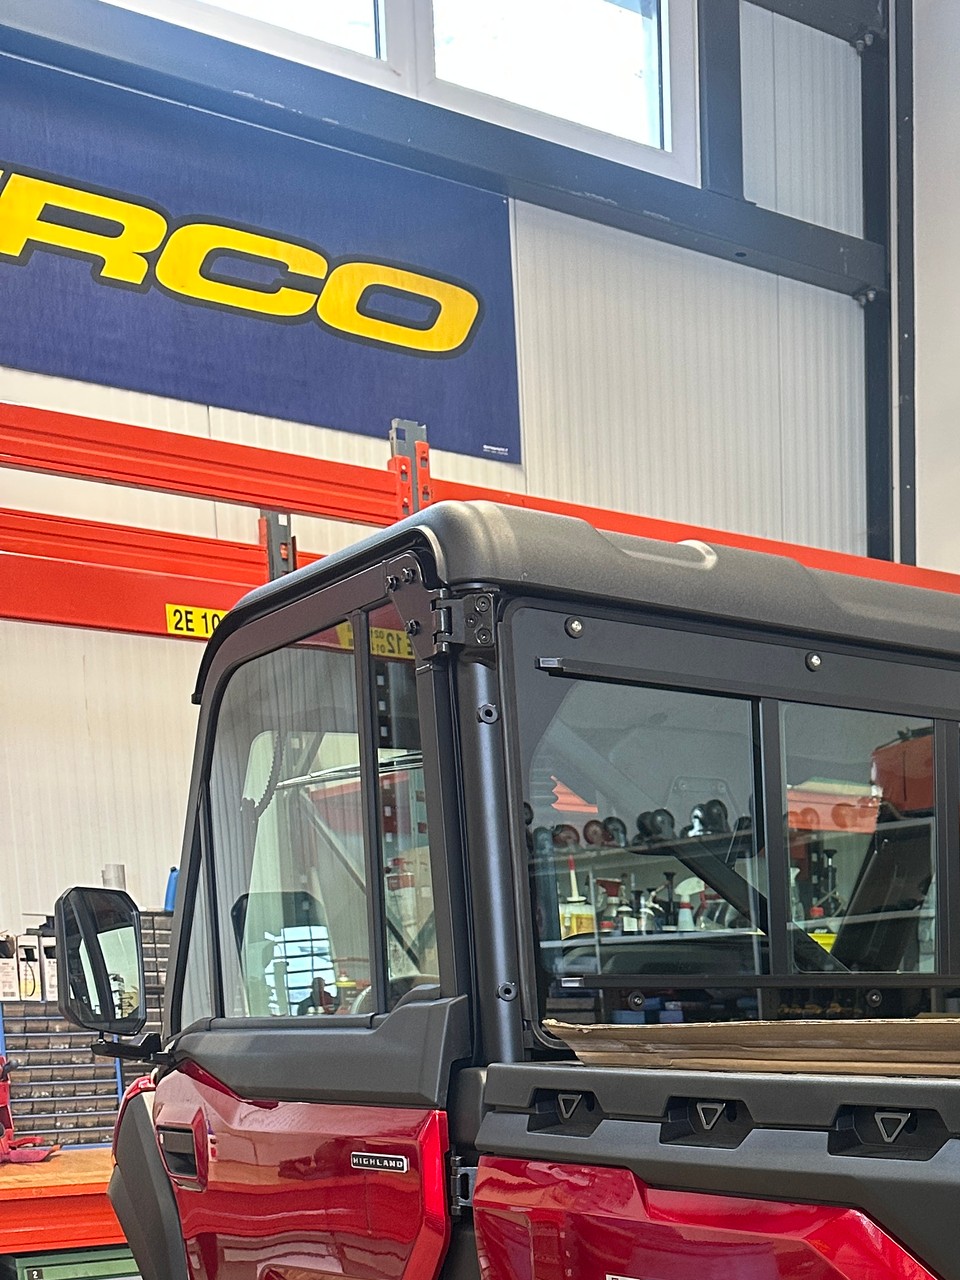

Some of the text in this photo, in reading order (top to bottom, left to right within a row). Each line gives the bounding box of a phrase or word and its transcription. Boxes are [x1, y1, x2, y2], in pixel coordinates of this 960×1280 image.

[0, 168, 480, 353] RCO
[173, 608, 195, 633] 2E
[352, 1157, 404, 1168] HIGHLAND
[32, 1270, 39, 1279] 2
